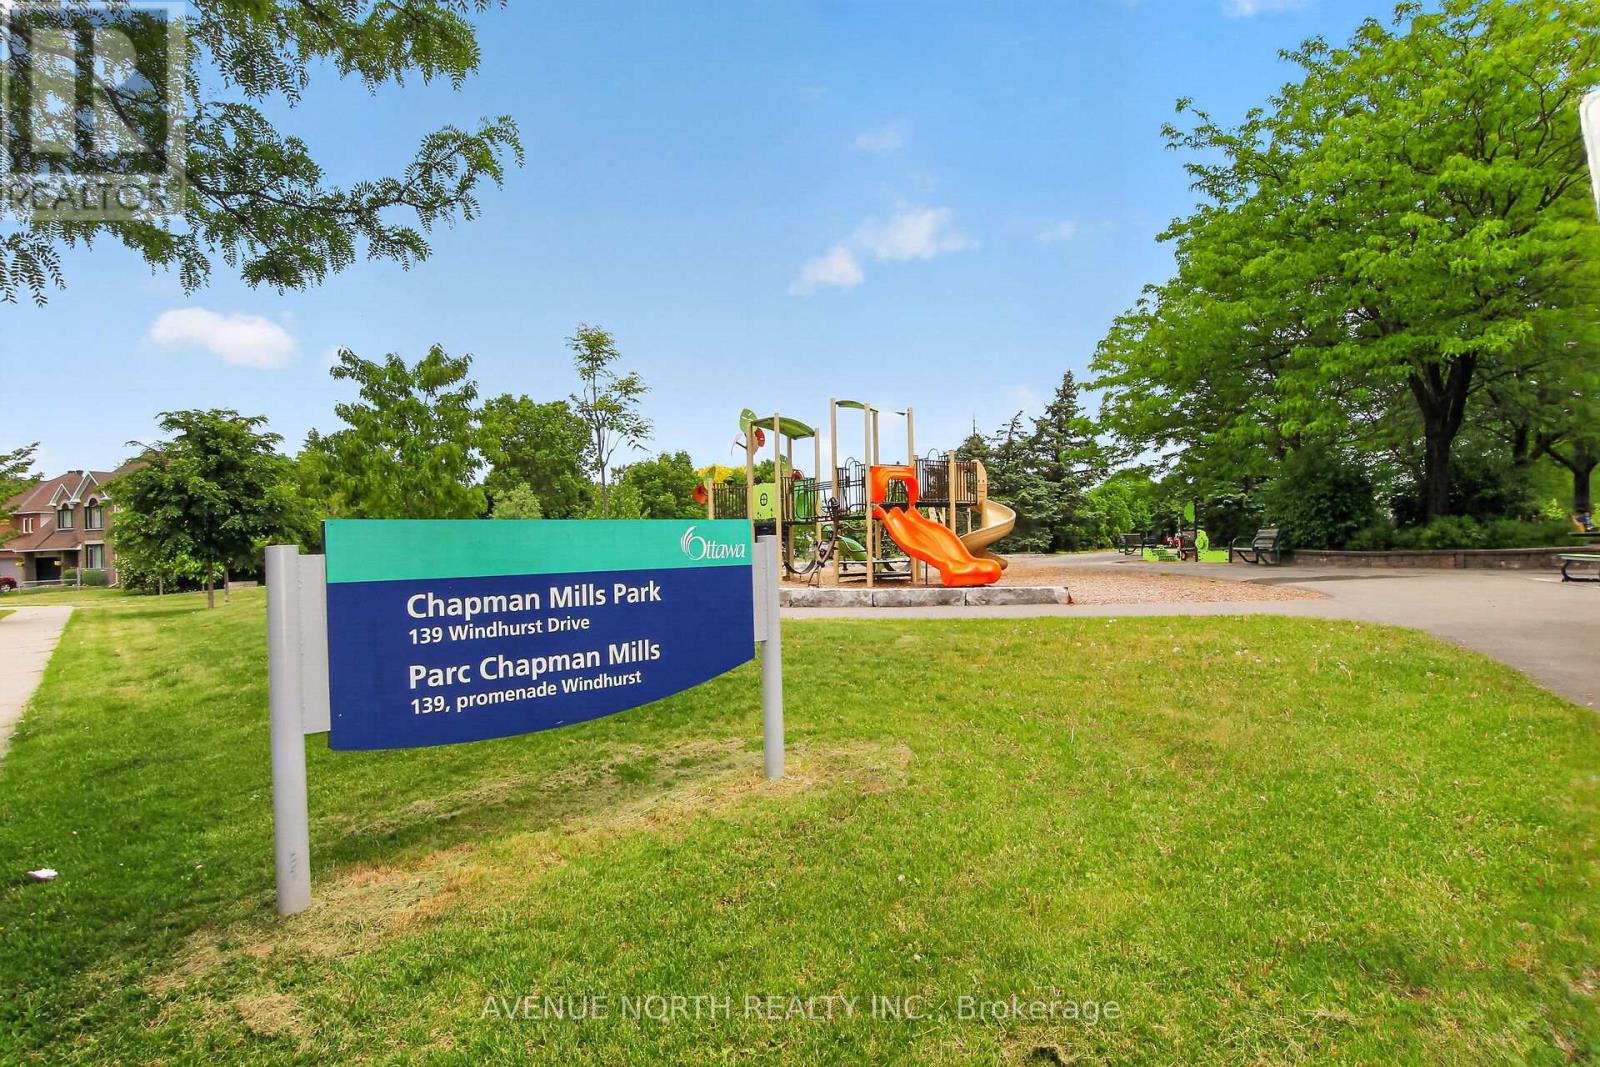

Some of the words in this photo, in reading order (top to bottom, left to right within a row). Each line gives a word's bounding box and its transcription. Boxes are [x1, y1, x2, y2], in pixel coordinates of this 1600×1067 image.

[680, 526, 746, 561] Ottawa
[406, 590, 541, 621] Chapman
[549, 583, 606, 609] Mills
[613, 580, 662, 605] Park
[408, 626, 443, 645] 139
[448, 619, 543, 642] Windhurst
[547, 616, 590, 633] Drive
[408, 660, 471, 690] Parc
[479, 649, 601, 681] Chapman
[608, 638, 661, 666] Mills
[410, 695, 451, 715] 139,
[456, 682, 557, 713] promenade
[561, 669, 642, 694] Windhurst
